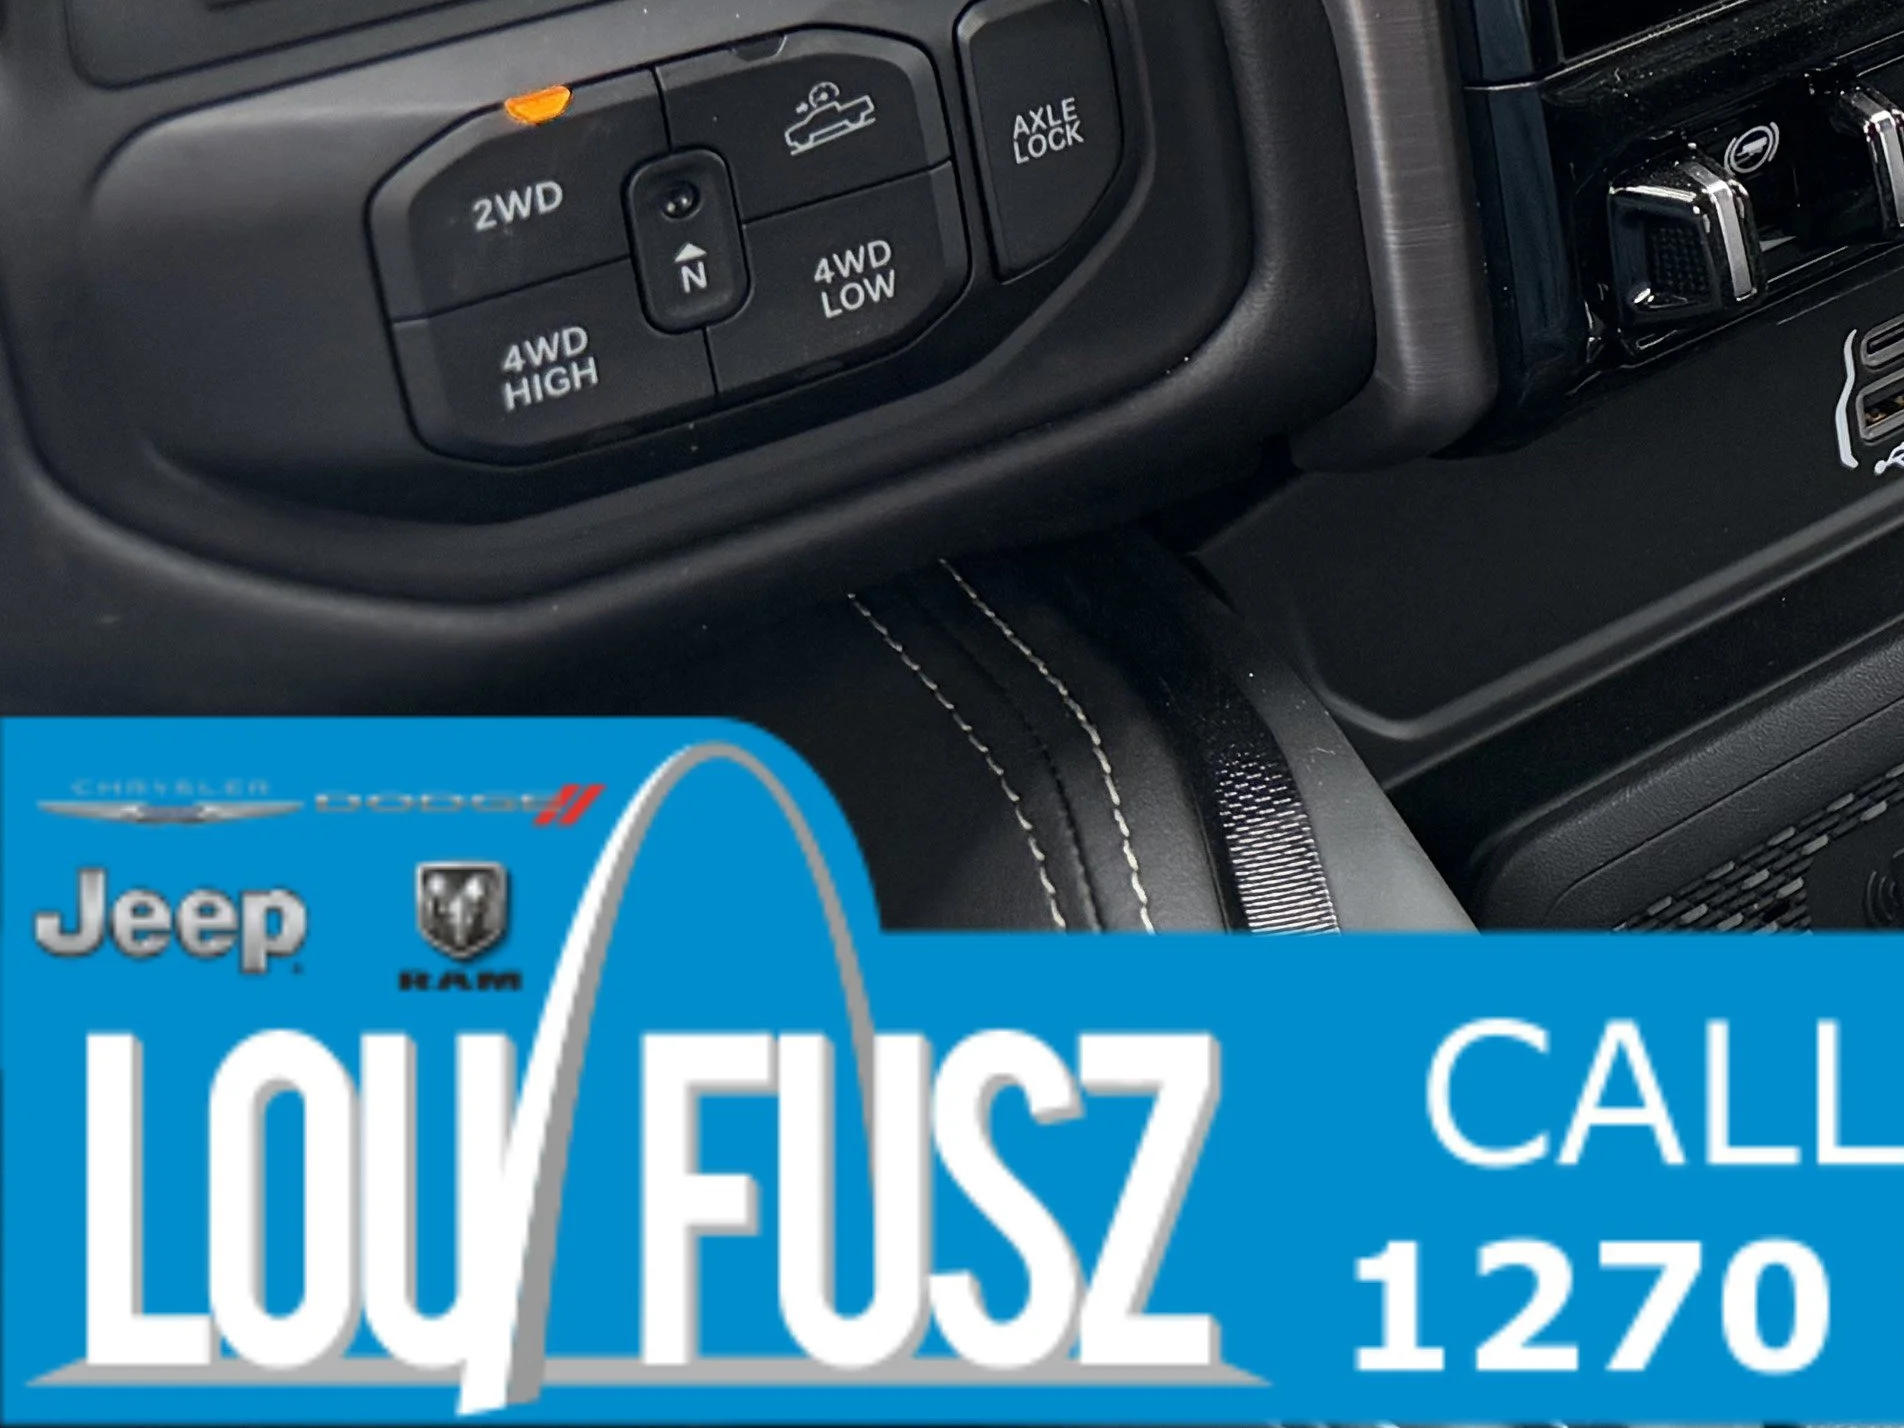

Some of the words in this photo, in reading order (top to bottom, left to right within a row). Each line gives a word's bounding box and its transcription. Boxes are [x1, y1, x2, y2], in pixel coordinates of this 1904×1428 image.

[1010, 94, 1080, 140] AXLE
[1010, 117, 1086, 165] LOCK
[471, 178, 566, 231] 2WD
[680, 260, 709, 294] N
[811, 238, 896, 287] 4WD
[818, 267, 898, 319] LOW
[499, 324, 592, 378] 4WD
[500, 353, 600, 412] HIGH
